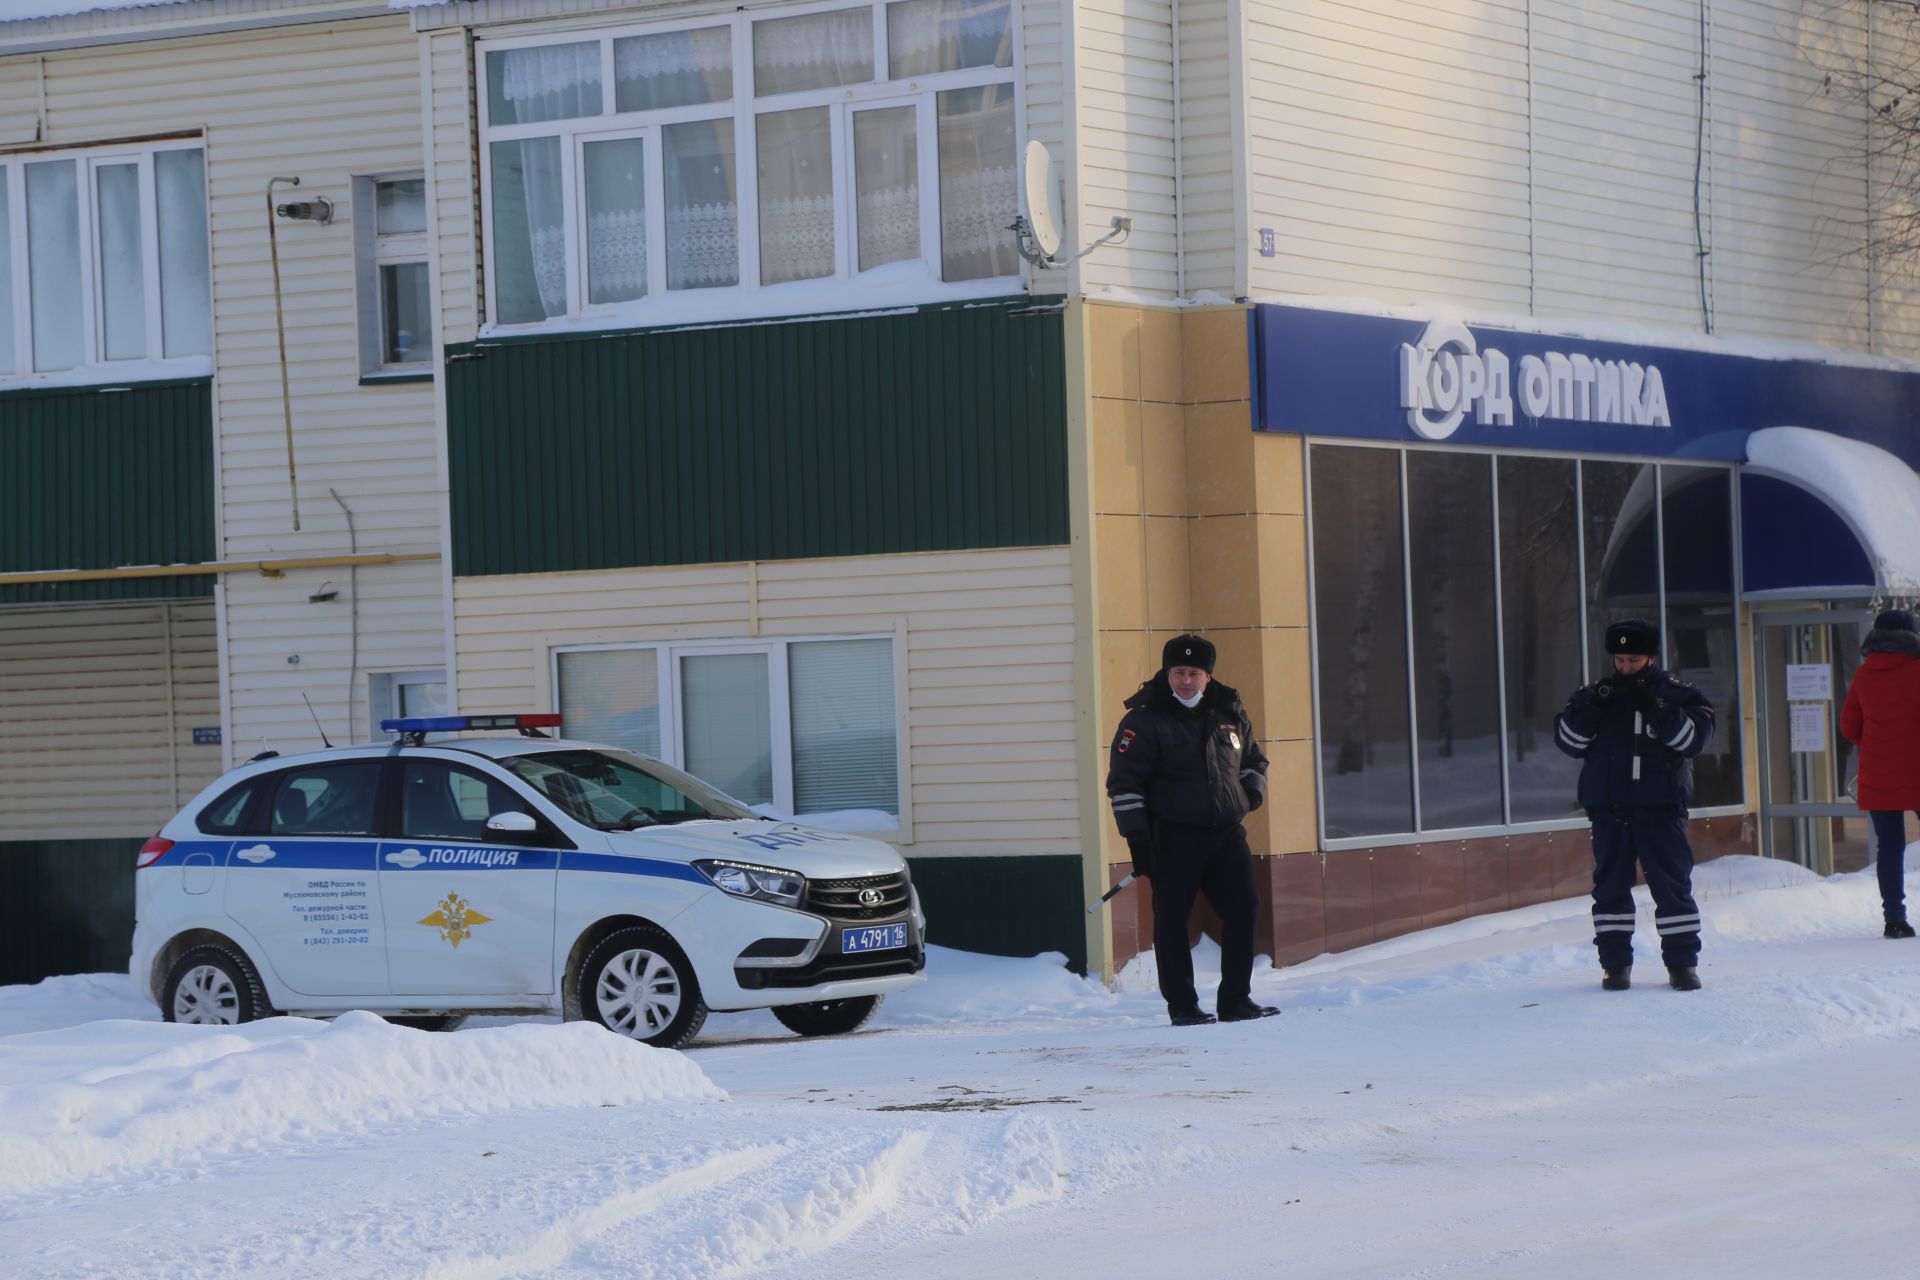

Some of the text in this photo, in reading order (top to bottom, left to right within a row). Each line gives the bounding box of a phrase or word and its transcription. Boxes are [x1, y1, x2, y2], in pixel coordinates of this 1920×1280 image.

[1264, 233, 1273, 251] 57
[1400, 336, 1672, 432] КОРД ОПТИКА
[737, 831, 849, 850] ДПС
[428, 848, 520, 868] ПОЛИЦИЯ
[341, 889, 366, 898] району
[308, 904, 344, 912] дежурной
[860, 928, 889, 948] 4791
[894, 925, 904, 939] 16
